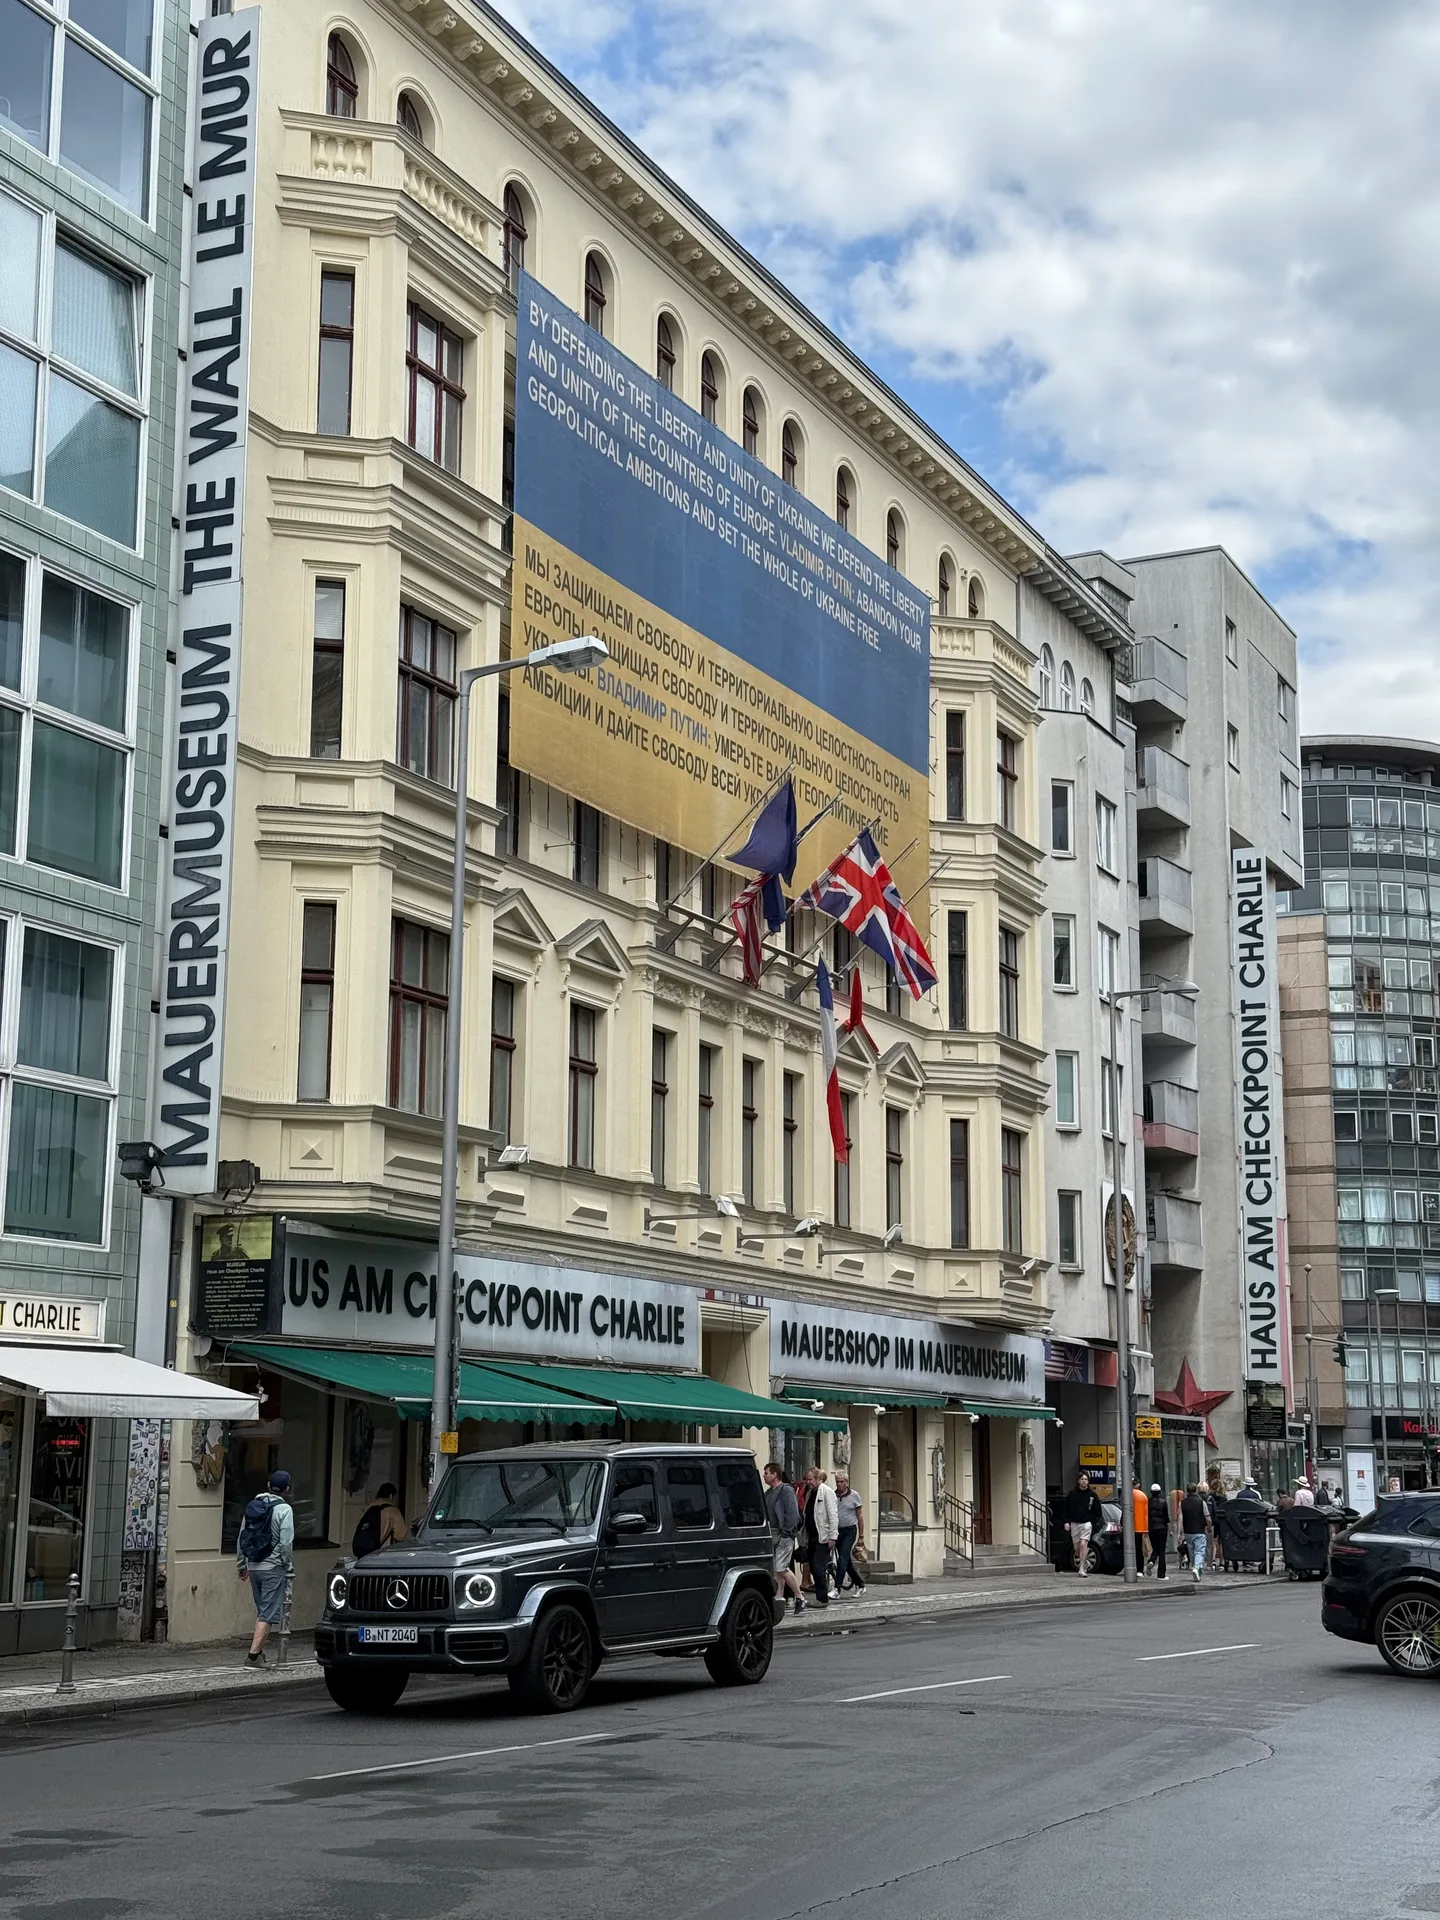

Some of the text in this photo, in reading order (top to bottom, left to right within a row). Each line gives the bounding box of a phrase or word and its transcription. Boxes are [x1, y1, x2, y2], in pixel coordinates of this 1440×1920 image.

[528, 339, 922, 654] AND UNITY OF THE COUNTRIES OF EUROPE. VLADIMIR PUTIN: ABANDON YOUR
[528, 375, 882, 652] GEOPOLITICAL AMBITIONS AND SET THE WHOLE OF UKRAINE FREE.
[529, 299, 925, 627] BY DEFENDING THE LIBERTY AND UNITY OF UKRAINE WE DEFEND THE LIBERTY
[160, 29, 251, 1167] MAUERMUSEUM THE WALL LE MUR
[525, 544, 911, 801] МЫ ЗАЩИЩАЕМ СВОБОДУ И ТЕРРИТОРИАЛЬНУЮ ЦЕЛОСТНОСТЬ СТРАН
[522, 664, 591, 721] АМБИЦИИ
[594, 702, 604, 728] И
[606, 709, 649, 752] ДАЙТЕ
[652, 734, 709, 784] СВОБОДУ
[712, 764, 741, 800] ВСЕЙ
[524, 620, 594, 686] УКРЫ.
[597, 666, 667, 724] ВЛАДИМИР
[670, 706, 711, 749] ПУТИН:
[714, 730, 764, 778] УМЕРЬТЕ
[662, 668, 718, 720] СВОБОДУ
[720, 701, 728, 725] И
[731, 707, 833, 784] ТЕРРИТОРИАЛЬНУЮ
[835, 768, 899, 824] ЦЕЛОСТНОСТЬ
[1236, 856, 1279, 1371] HAUS AM CHECKPOINT CHARLIE
[13, 1302, 81, 1331] CHARLIE
[283, 1256, 330, 1308] US
[339, 1264, 394, 1315] AM
[590, 1294, 685, 1346] CHARLIE
[781, 1320, 1026, 1383] MAUERSHOP IM MAUERMUSEUM
[366, 1629, 416, 1641] B NT 2040
